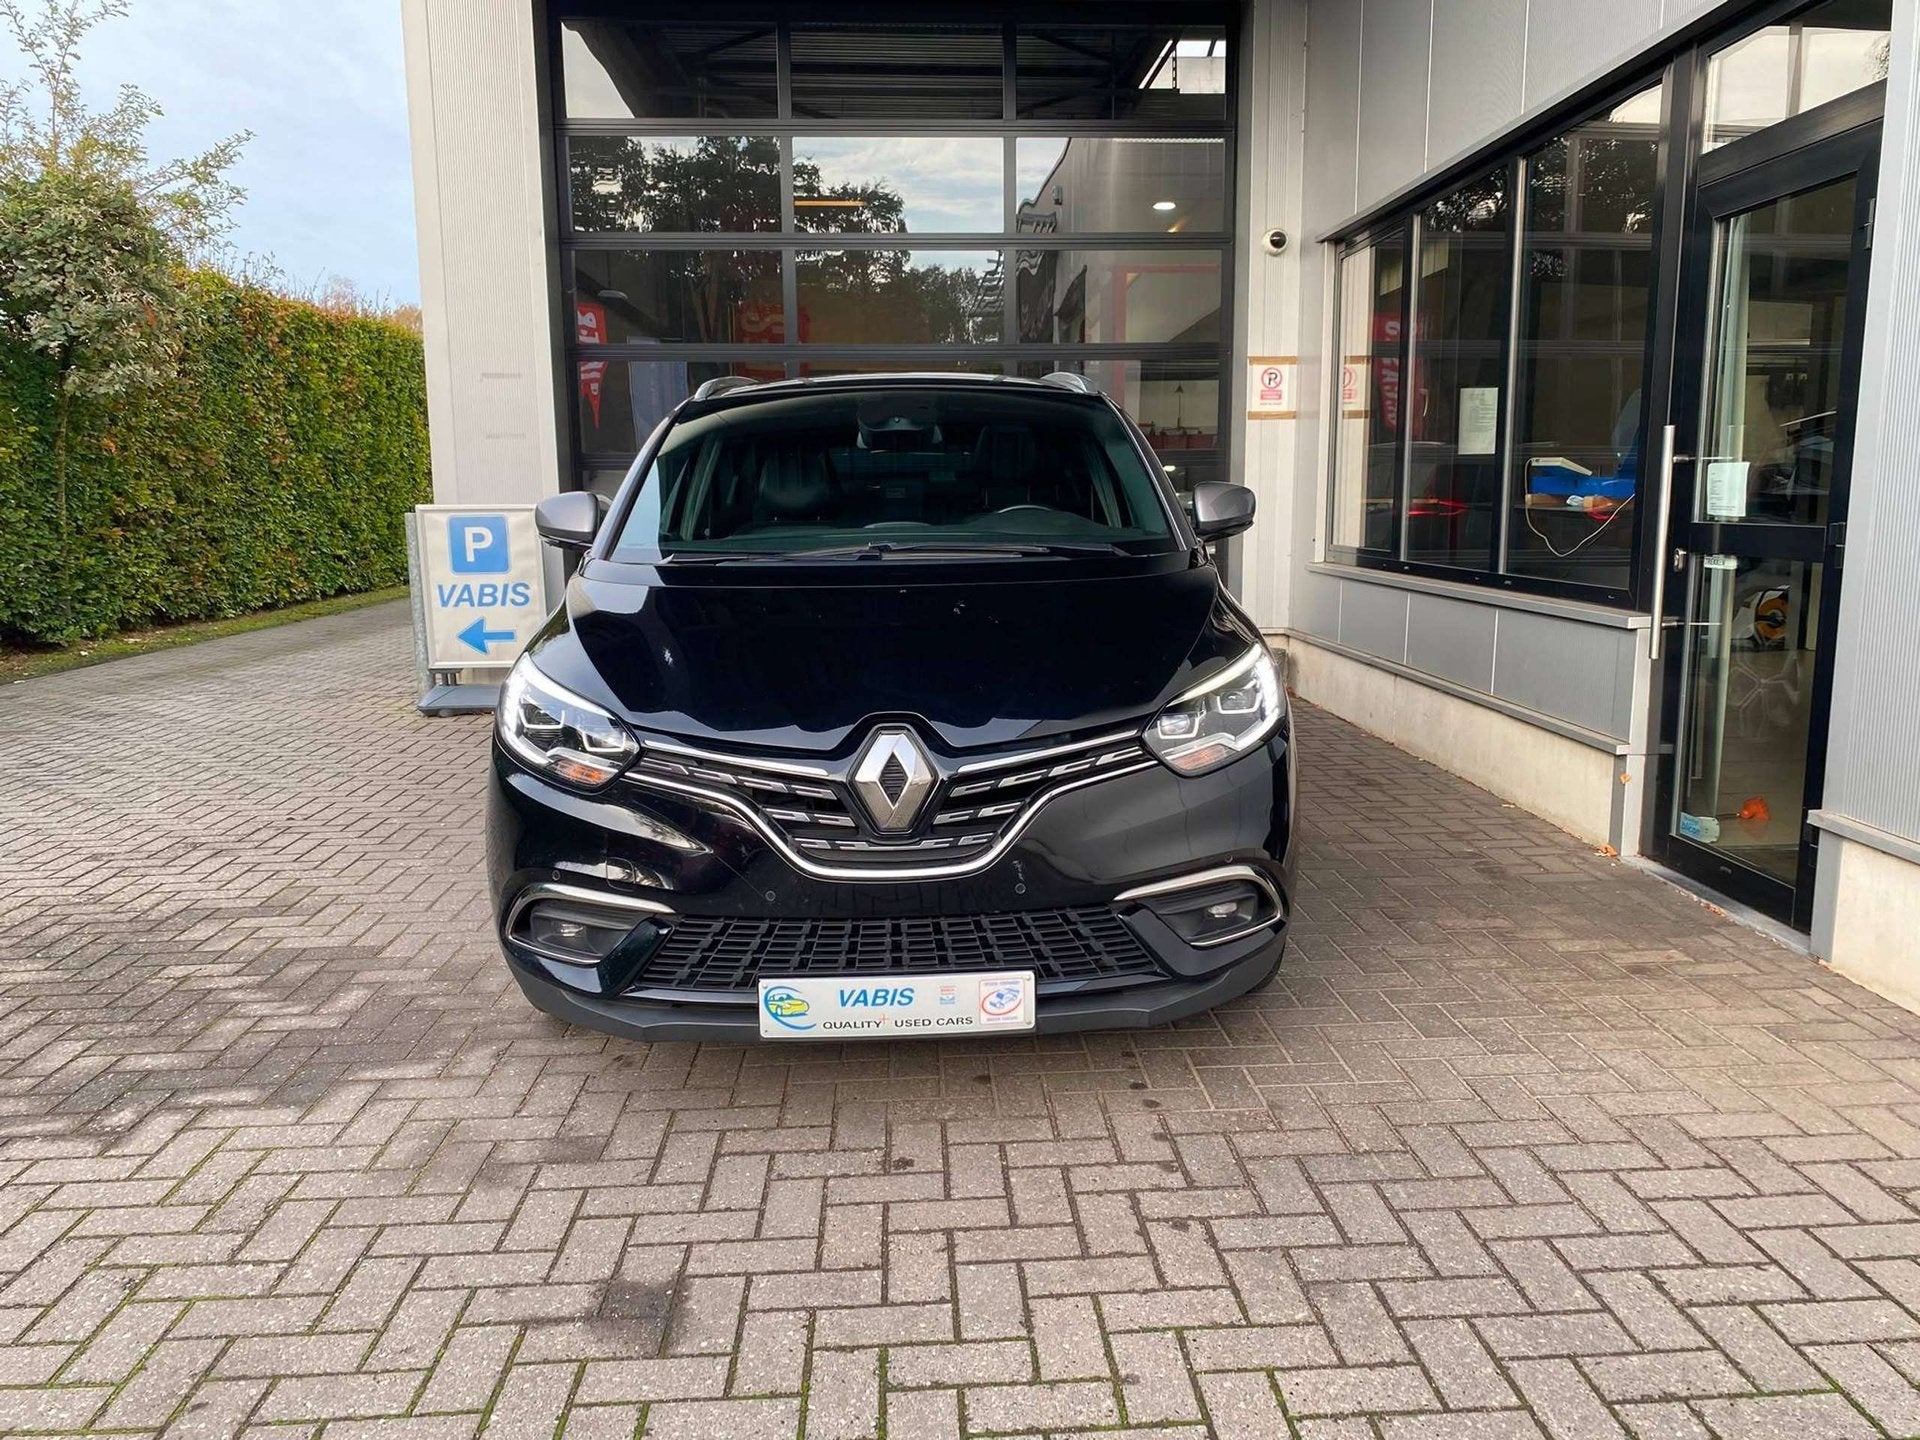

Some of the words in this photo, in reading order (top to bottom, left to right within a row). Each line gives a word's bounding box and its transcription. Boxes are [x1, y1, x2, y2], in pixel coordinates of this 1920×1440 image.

[464, 526, 494, 562] P
[437, 583, 530, 607] VABIS
[839, 987, 915, 1008] VABIS
[822, 1020, 882, 1030] QUALITY
[894, 1018, 932, 1028] USED
[936, 1016, 974, 1027] CARS
